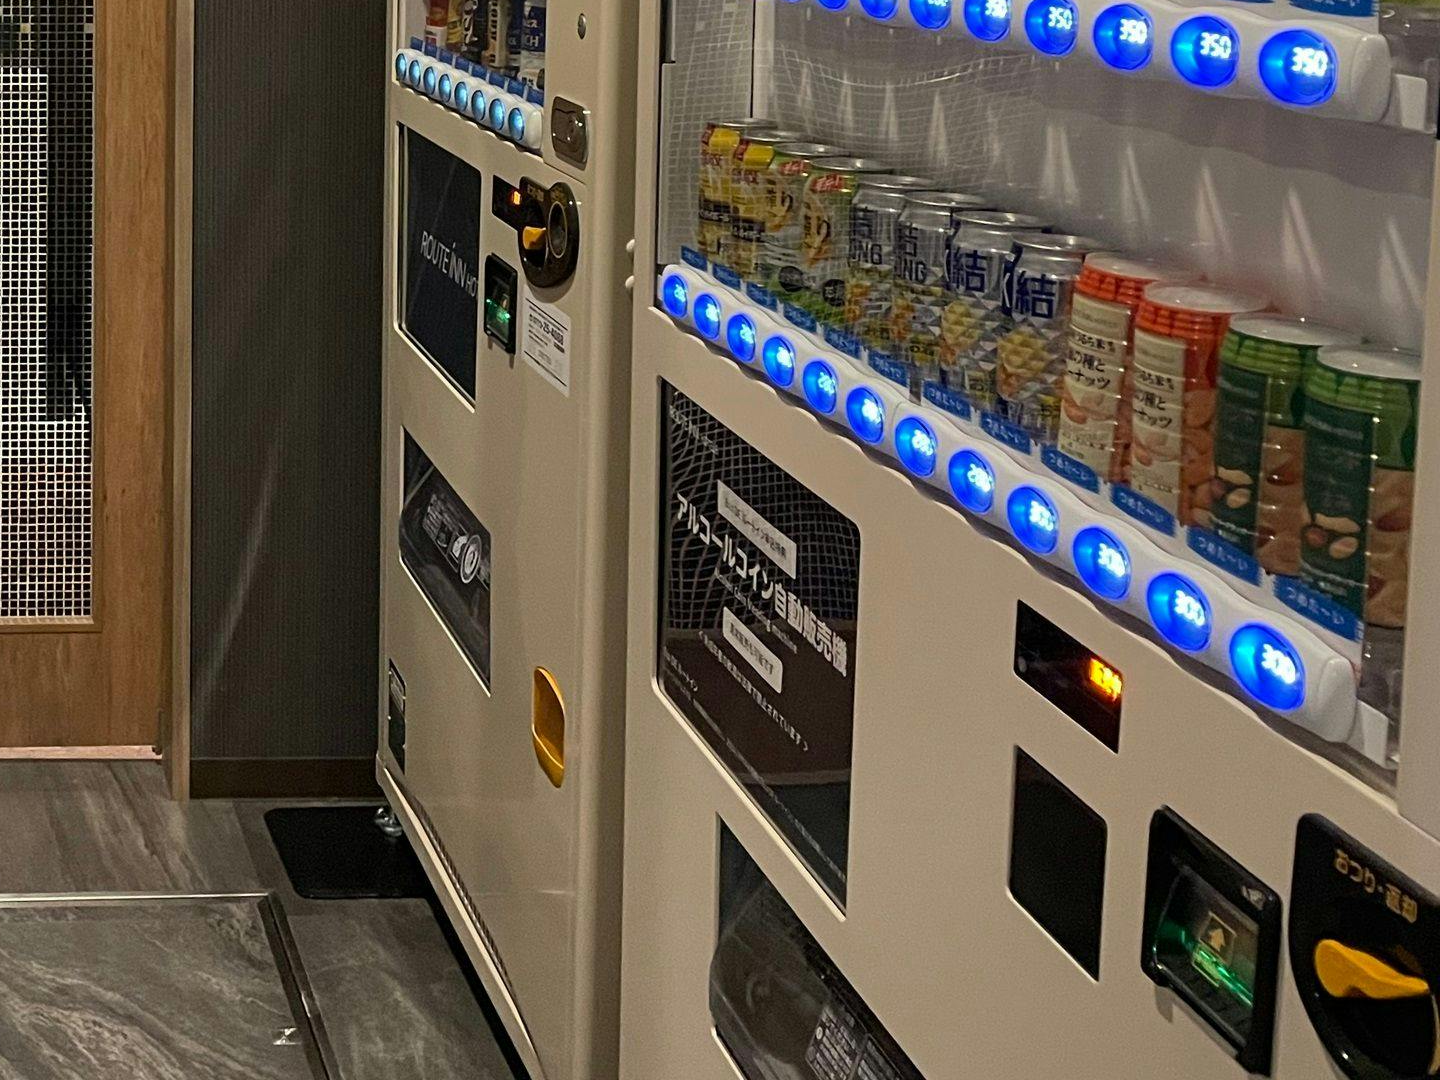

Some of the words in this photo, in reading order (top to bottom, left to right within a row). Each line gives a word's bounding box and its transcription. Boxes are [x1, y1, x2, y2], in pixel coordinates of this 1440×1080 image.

[1049, 6, 1072, 29] 350
[1120, 18, 1147, 44] 350
[1200, 31, 1231, 59] 350
[1292, 47, 1328, 76] 350
[420, 230, 449, 280] ROUTE
[449, 242, 467, 289] INN
[677, 491, 848, 679] アルコールコイン自動販売機
[1175, 589, 1205, 627] 300
[1262, 643, 1296, 685] 300
